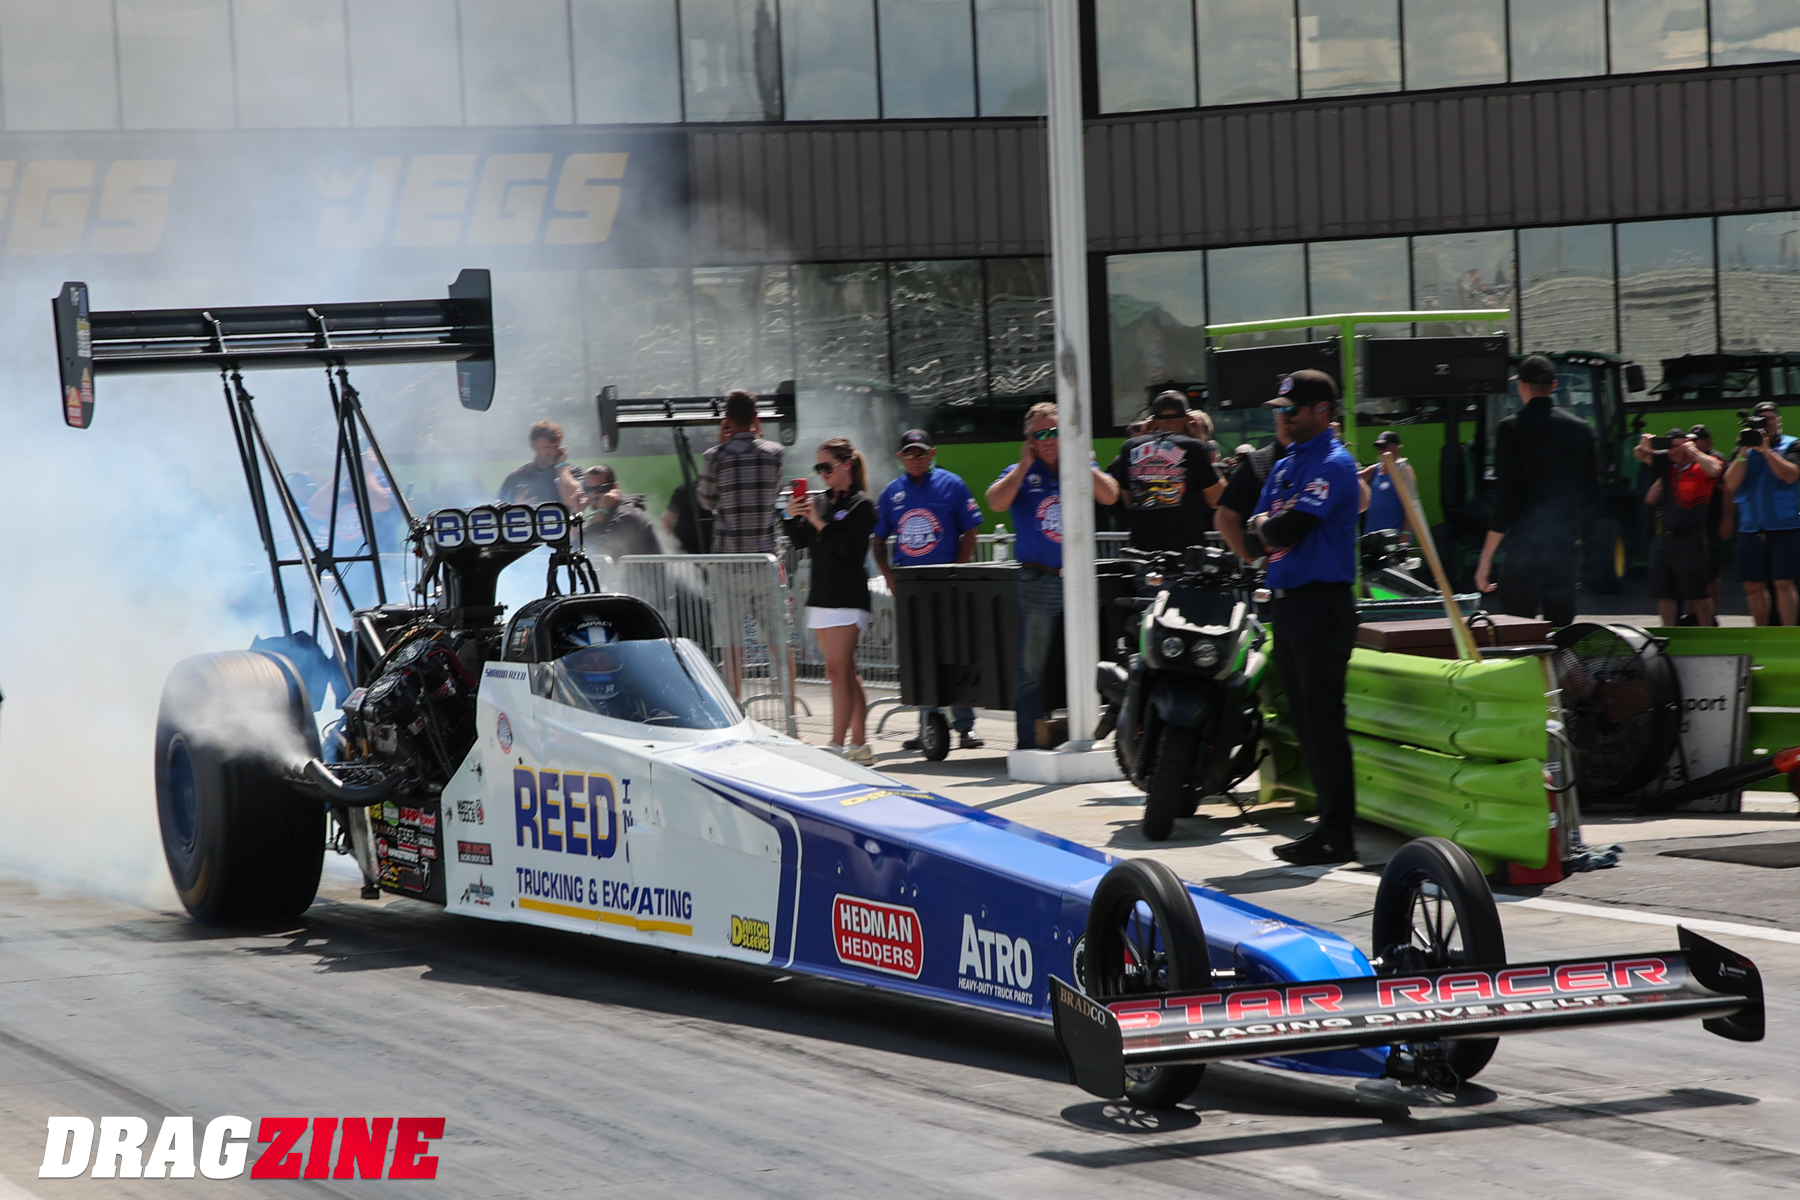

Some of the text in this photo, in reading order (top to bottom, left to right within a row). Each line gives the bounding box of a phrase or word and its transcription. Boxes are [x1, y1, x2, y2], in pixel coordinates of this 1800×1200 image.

[317, 152, 629, 249] JEGS
[436, 509, 563, 543] REED
[577, 620, 613, 631] IMPACT
[508, 671, 527, 681] REED
[513, 765, 619, 859] REED
[516, 867, 584, 904] TRUCKING
[588, 878, 598, 906] &
[731, 914, 769, 946] DARTON
[742, 933, 770, 953] SLEEVES
[839, 903, 913, 944] HEDMAN
[841, 935, 915, 969] HEDDERS
[958, 913, 1034, 990] ATRO
[958, 977, 1034, 1006] HEAVY-DUTY TRUCK PARTS
[1060, 987, 1106, 1027] BRADCO
[1107, 957, 1670, 1030] STAR RACER
[1188, 994, 1631, 1040] RACING DRIVE BELTS
